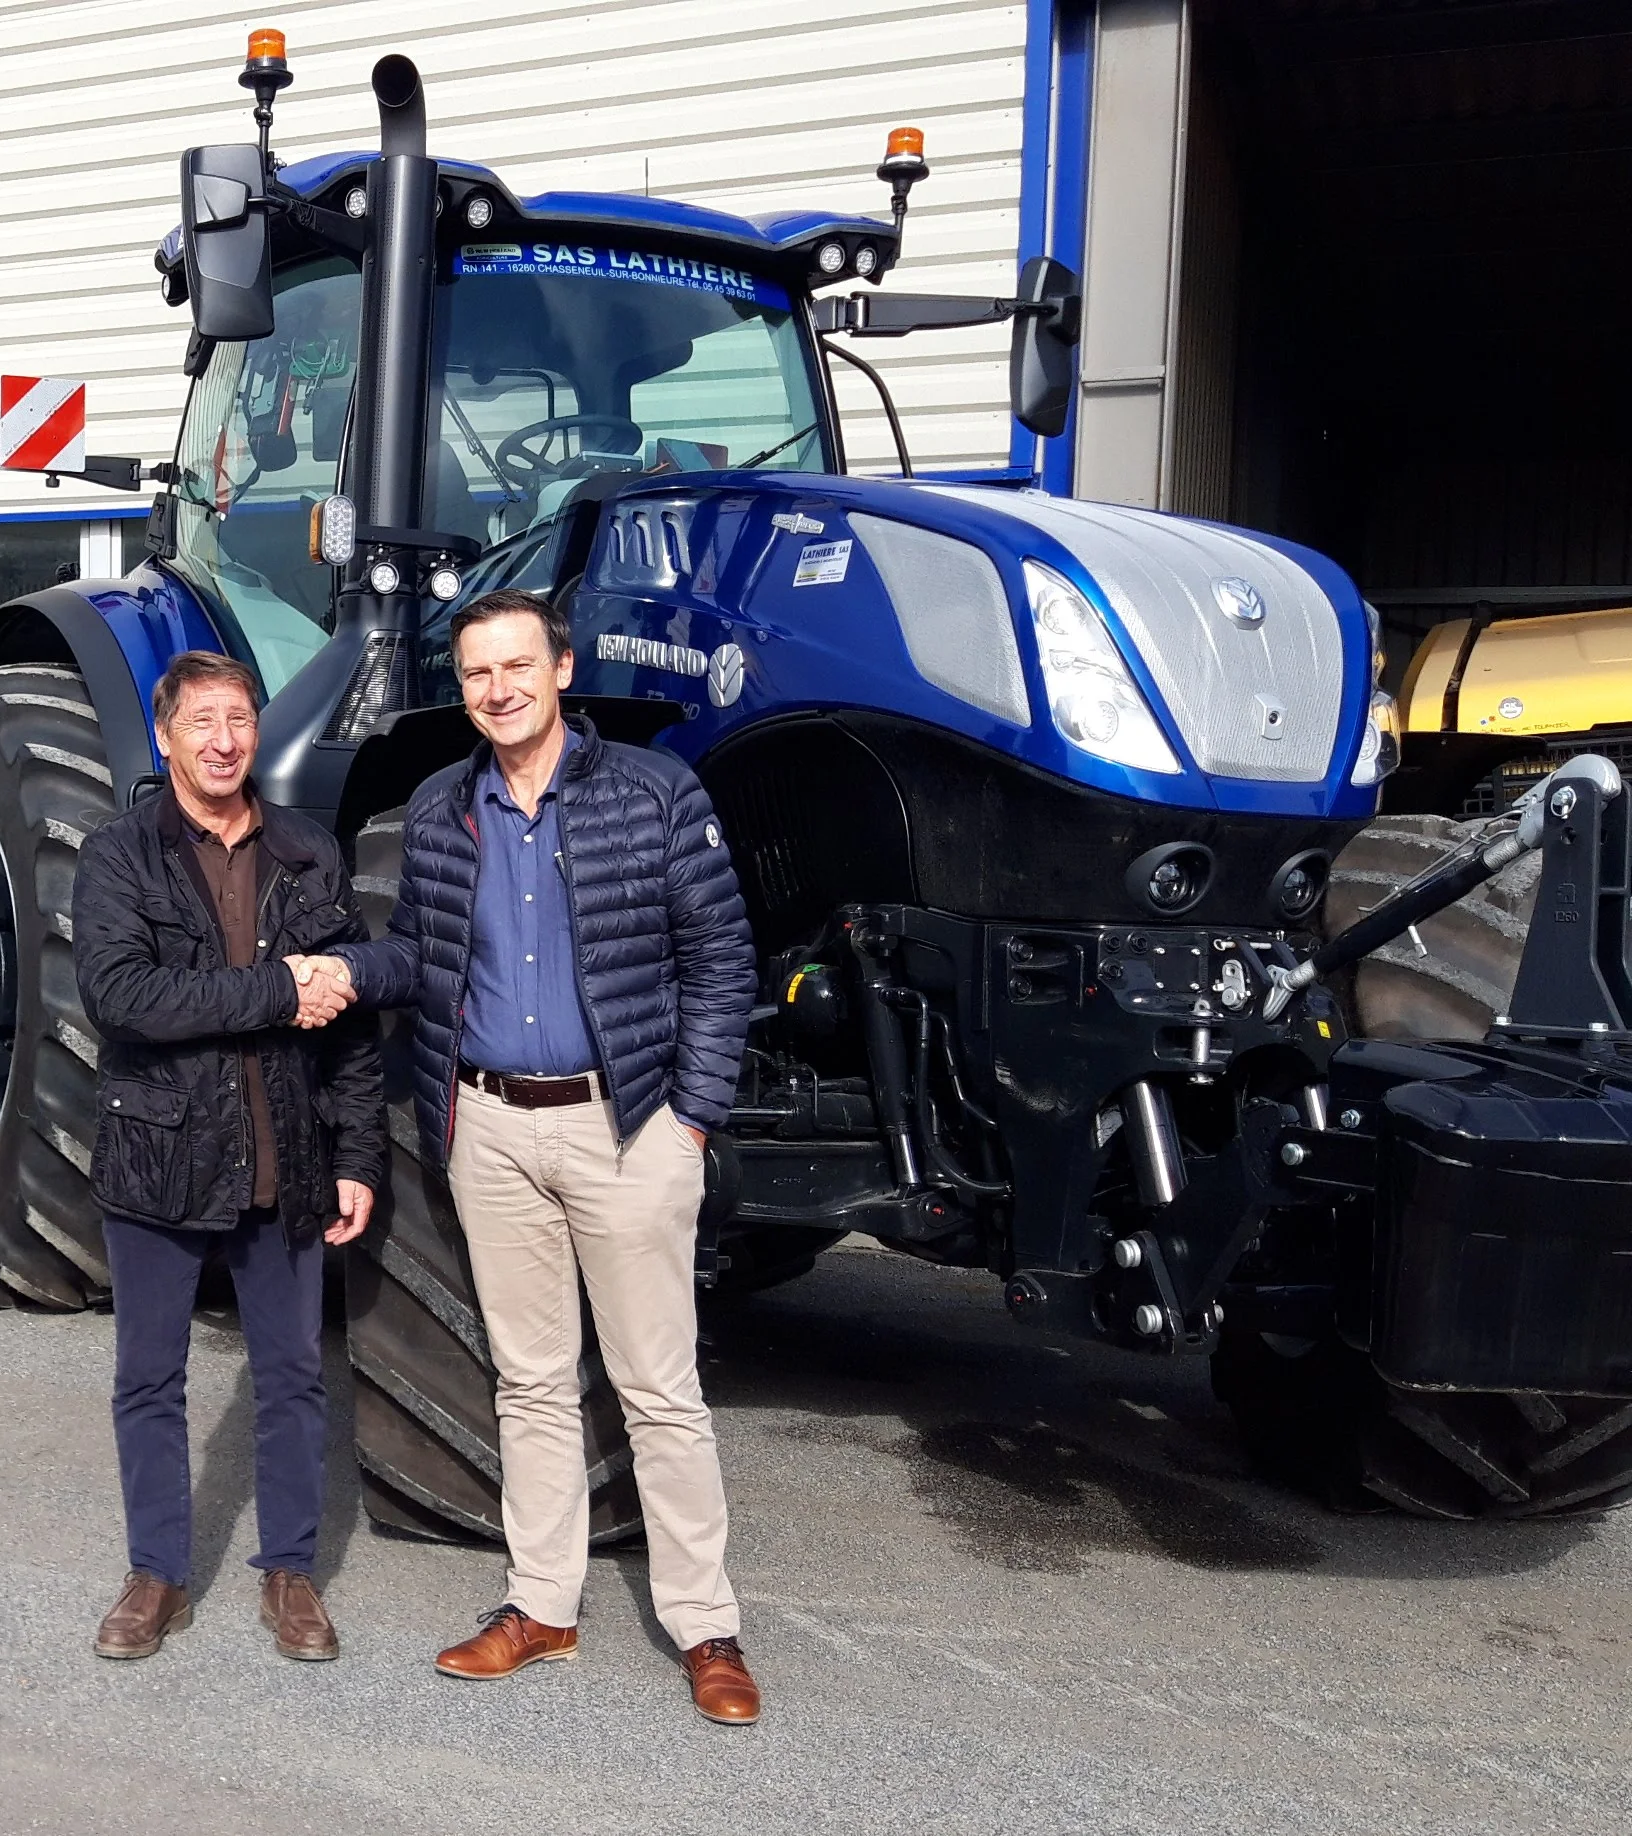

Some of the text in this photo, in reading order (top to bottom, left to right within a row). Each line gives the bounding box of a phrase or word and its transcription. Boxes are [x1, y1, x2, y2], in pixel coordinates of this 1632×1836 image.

[462, 264, 478, 273] RN
[481, 263, 497, 273] 141
[532, 243, 754, 291] SAS LATHIERE
[802, 546, 836, 560] LATHIERE
[627, 636, 707, 678] HOLLAND
